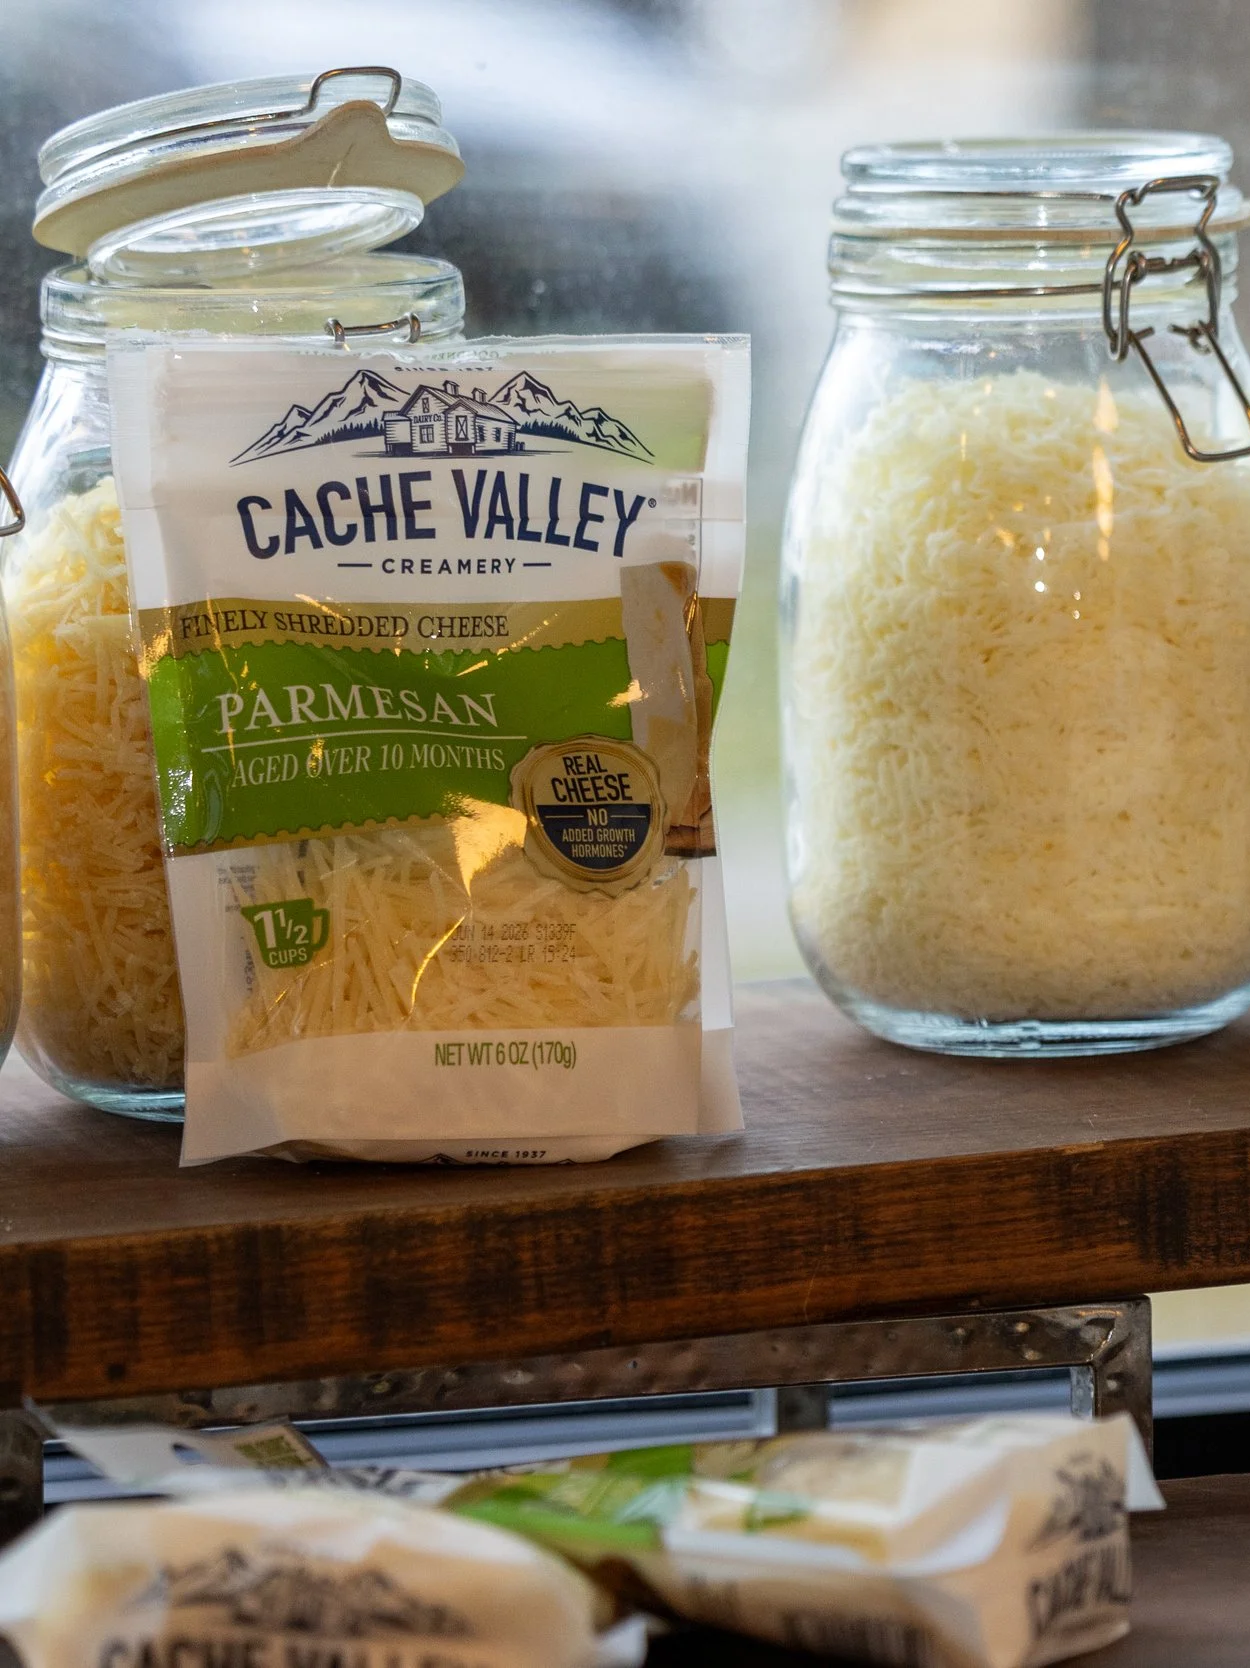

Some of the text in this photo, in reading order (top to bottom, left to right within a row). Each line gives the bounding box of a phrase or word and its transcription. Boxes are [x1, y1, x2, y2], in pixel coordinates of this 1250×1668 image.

[413, 414, 433, 425] DAIRY
[237, 470, 436, 560] CACHE
[381, 558, 517, 576] CREAMERY
[180, 609, 510, 639] FINELY SHREDDED CHEESE
[215, 683, 500, 735] PARMESAN
[231, 743, 506, 788] AGED OVER 10 MONTHS
[562, 754, 608, 776] REAL
[551, 773, 634, 803] CHEESE
[586, 808, 609, 826] NO
[562, 828, 636, 843] ADDED GROWTH
[268, 947, 308, 966] CUPS
[435, 1040, 577, 1071] NET WT 6 OZ (170g)
[465, 1149, 547, 1159] SINCE 1937
